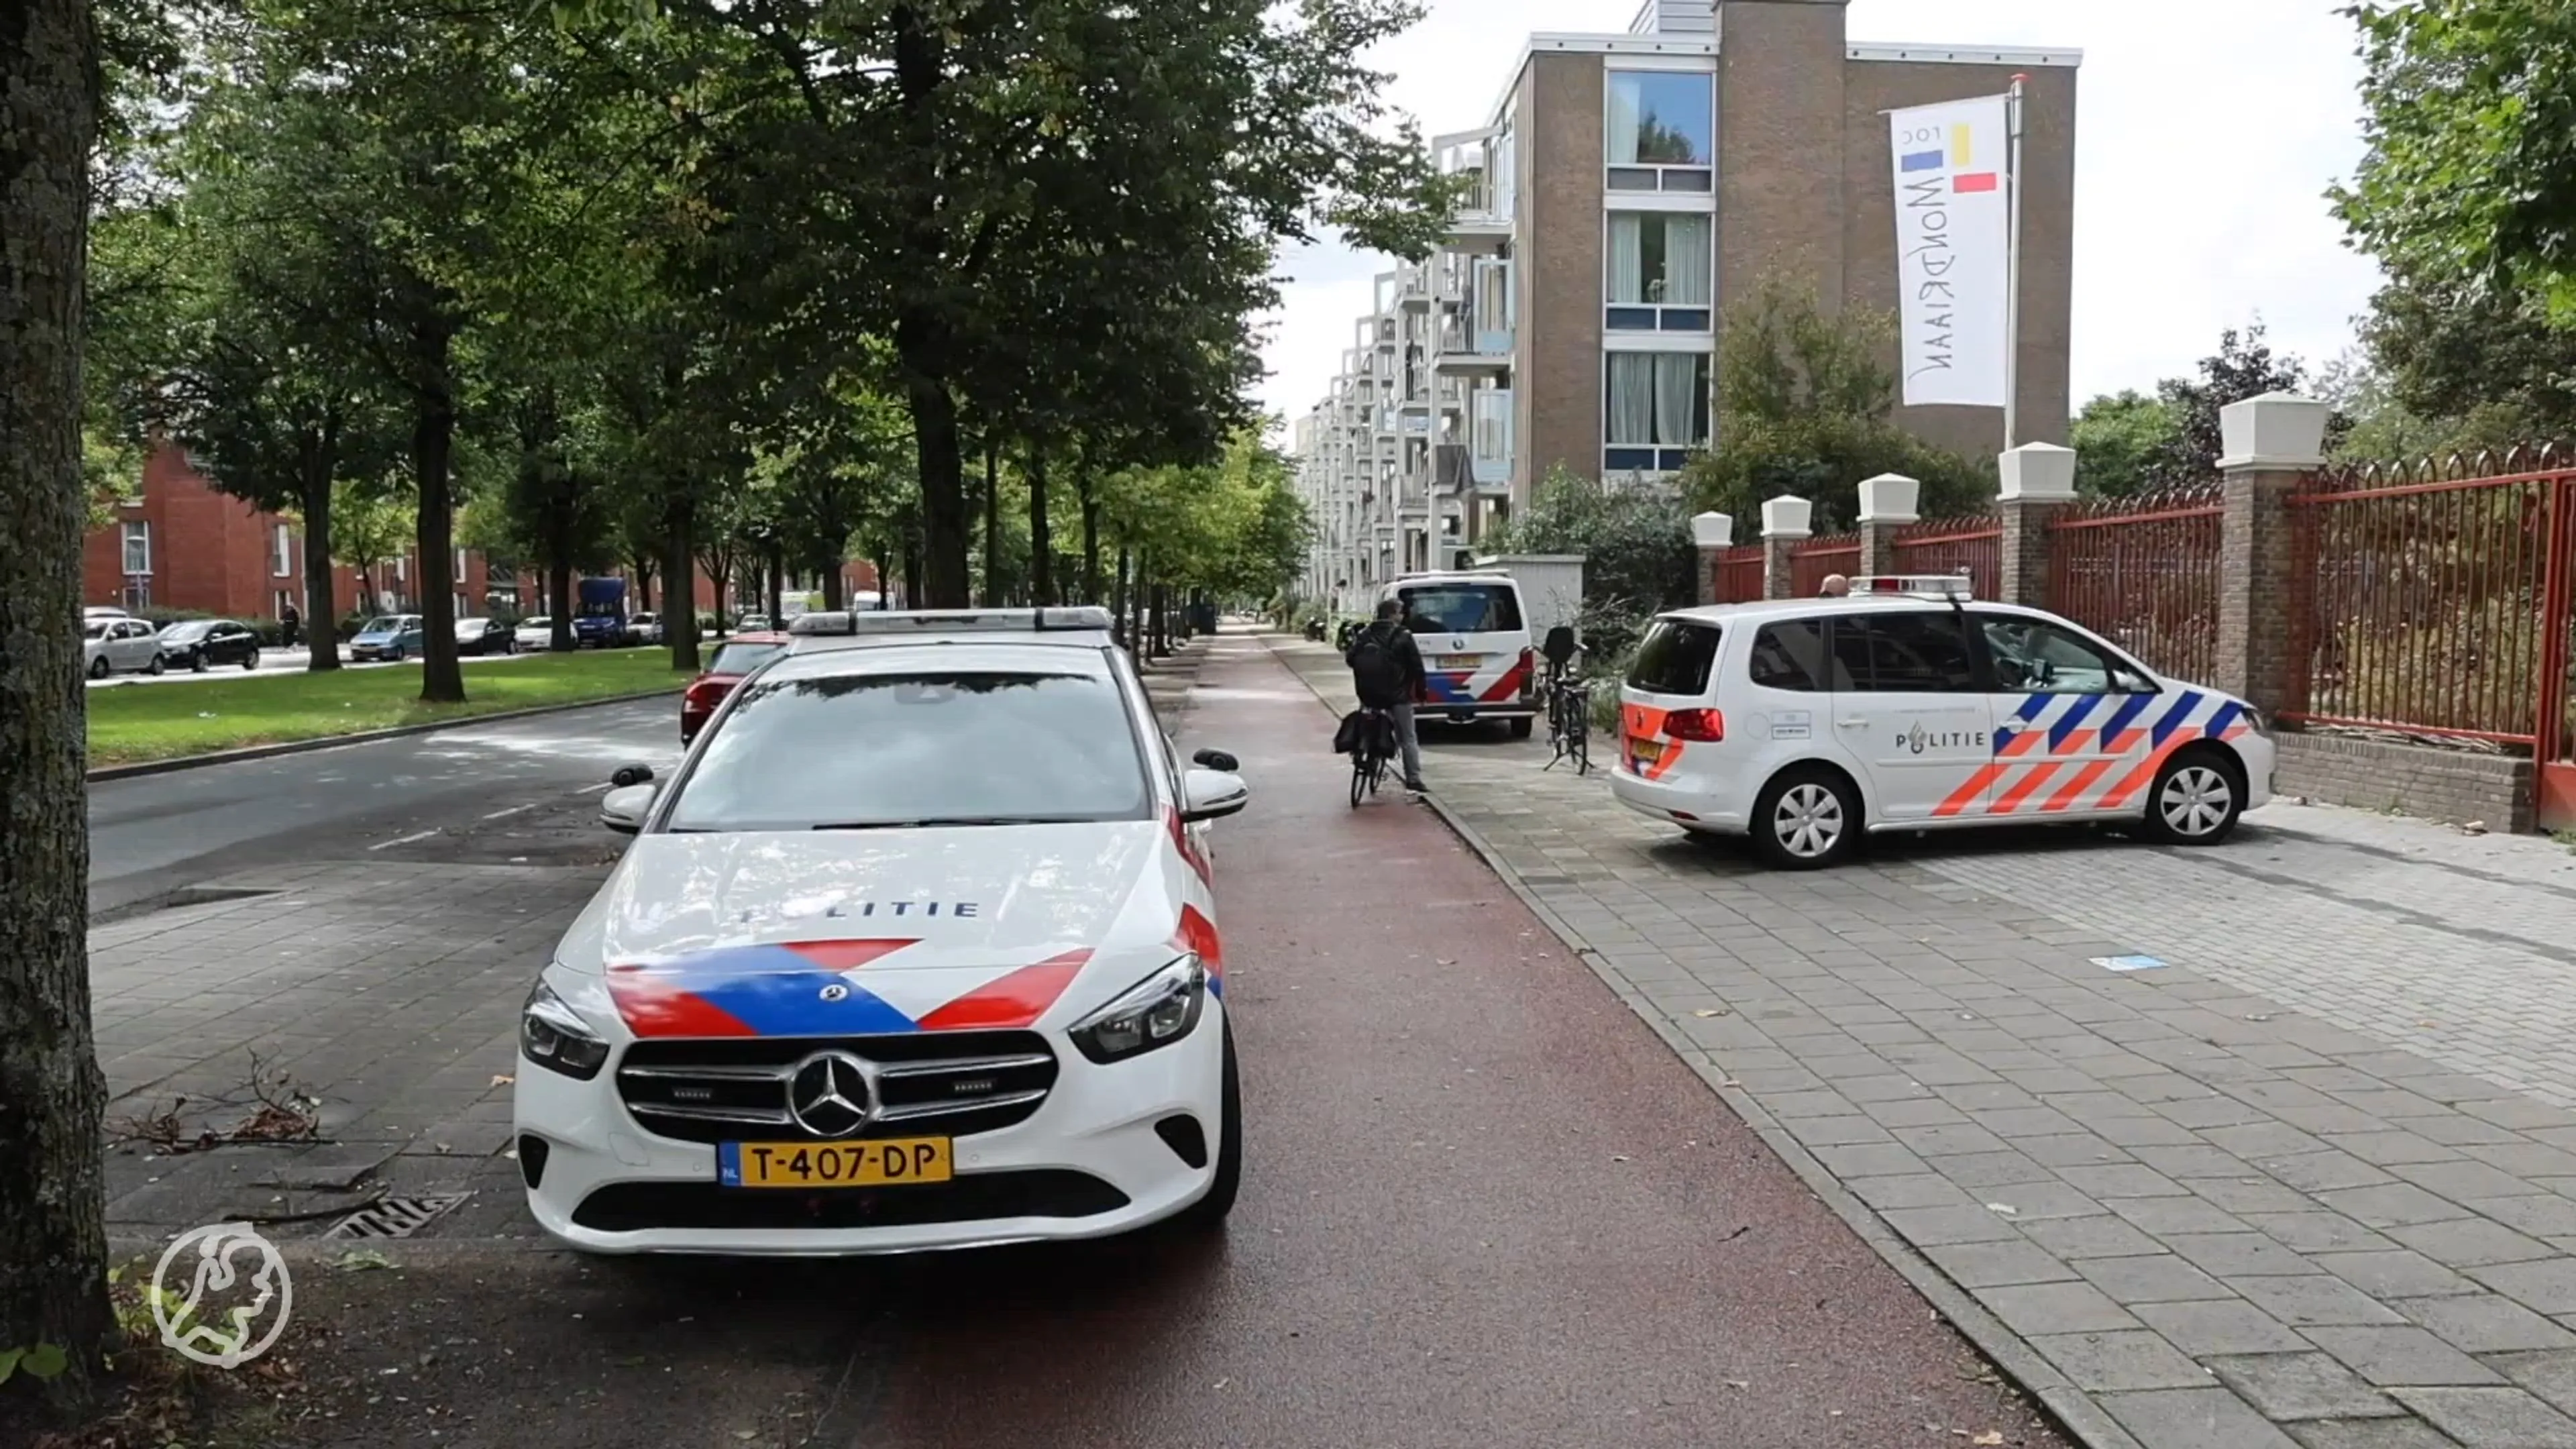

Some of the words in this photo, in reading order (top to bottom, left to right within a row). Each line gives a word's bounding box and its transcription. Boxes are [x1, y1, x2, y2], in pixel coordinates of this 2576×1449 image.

[1896, 732, 1984, 754] POLITIE
[741, 902, 979, 923] LITIE
[722, 1167, 737, 1179] NL
[752, 1144, 936, 1180] T-407-DP
